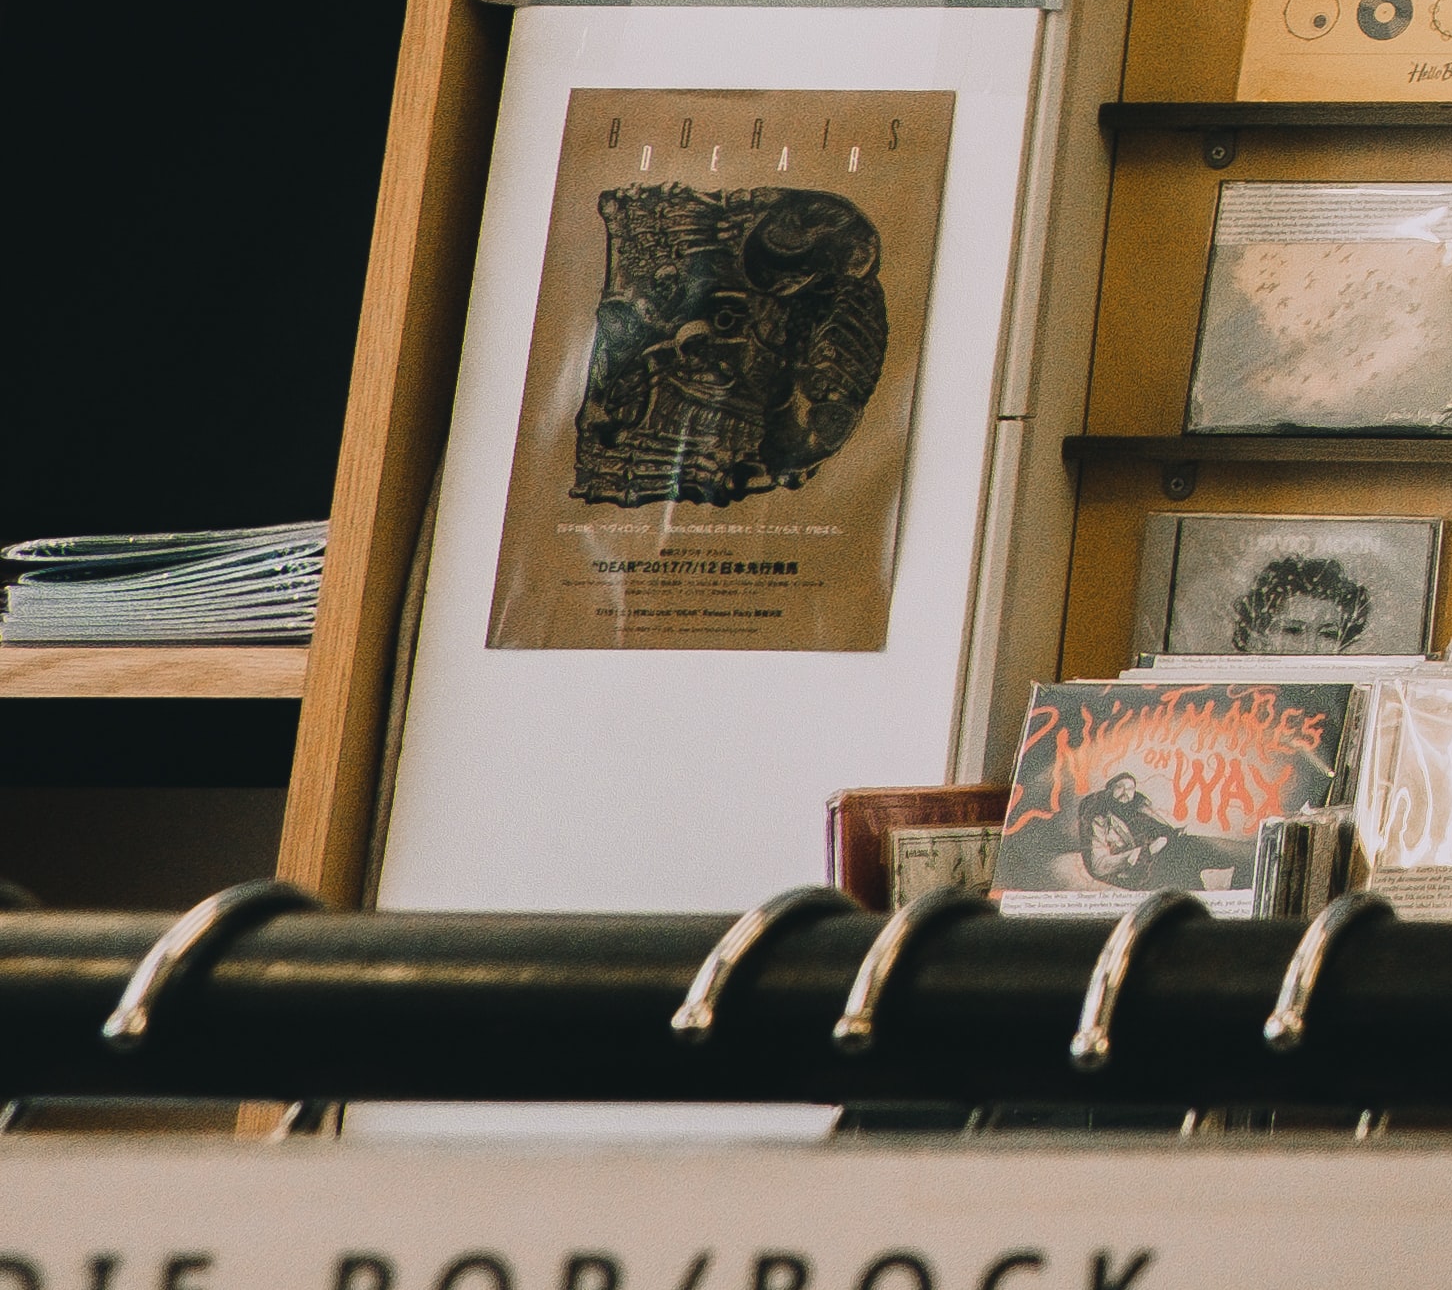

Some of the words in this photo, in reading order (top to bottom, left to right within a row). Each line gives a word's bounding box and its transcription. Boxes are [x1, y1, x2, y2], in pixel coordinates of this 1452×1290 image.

[640, 144, 862, 174] DEAR
[1143, 748, 1172, 769] ON
[1172, 750, 1295, 834] WAX
